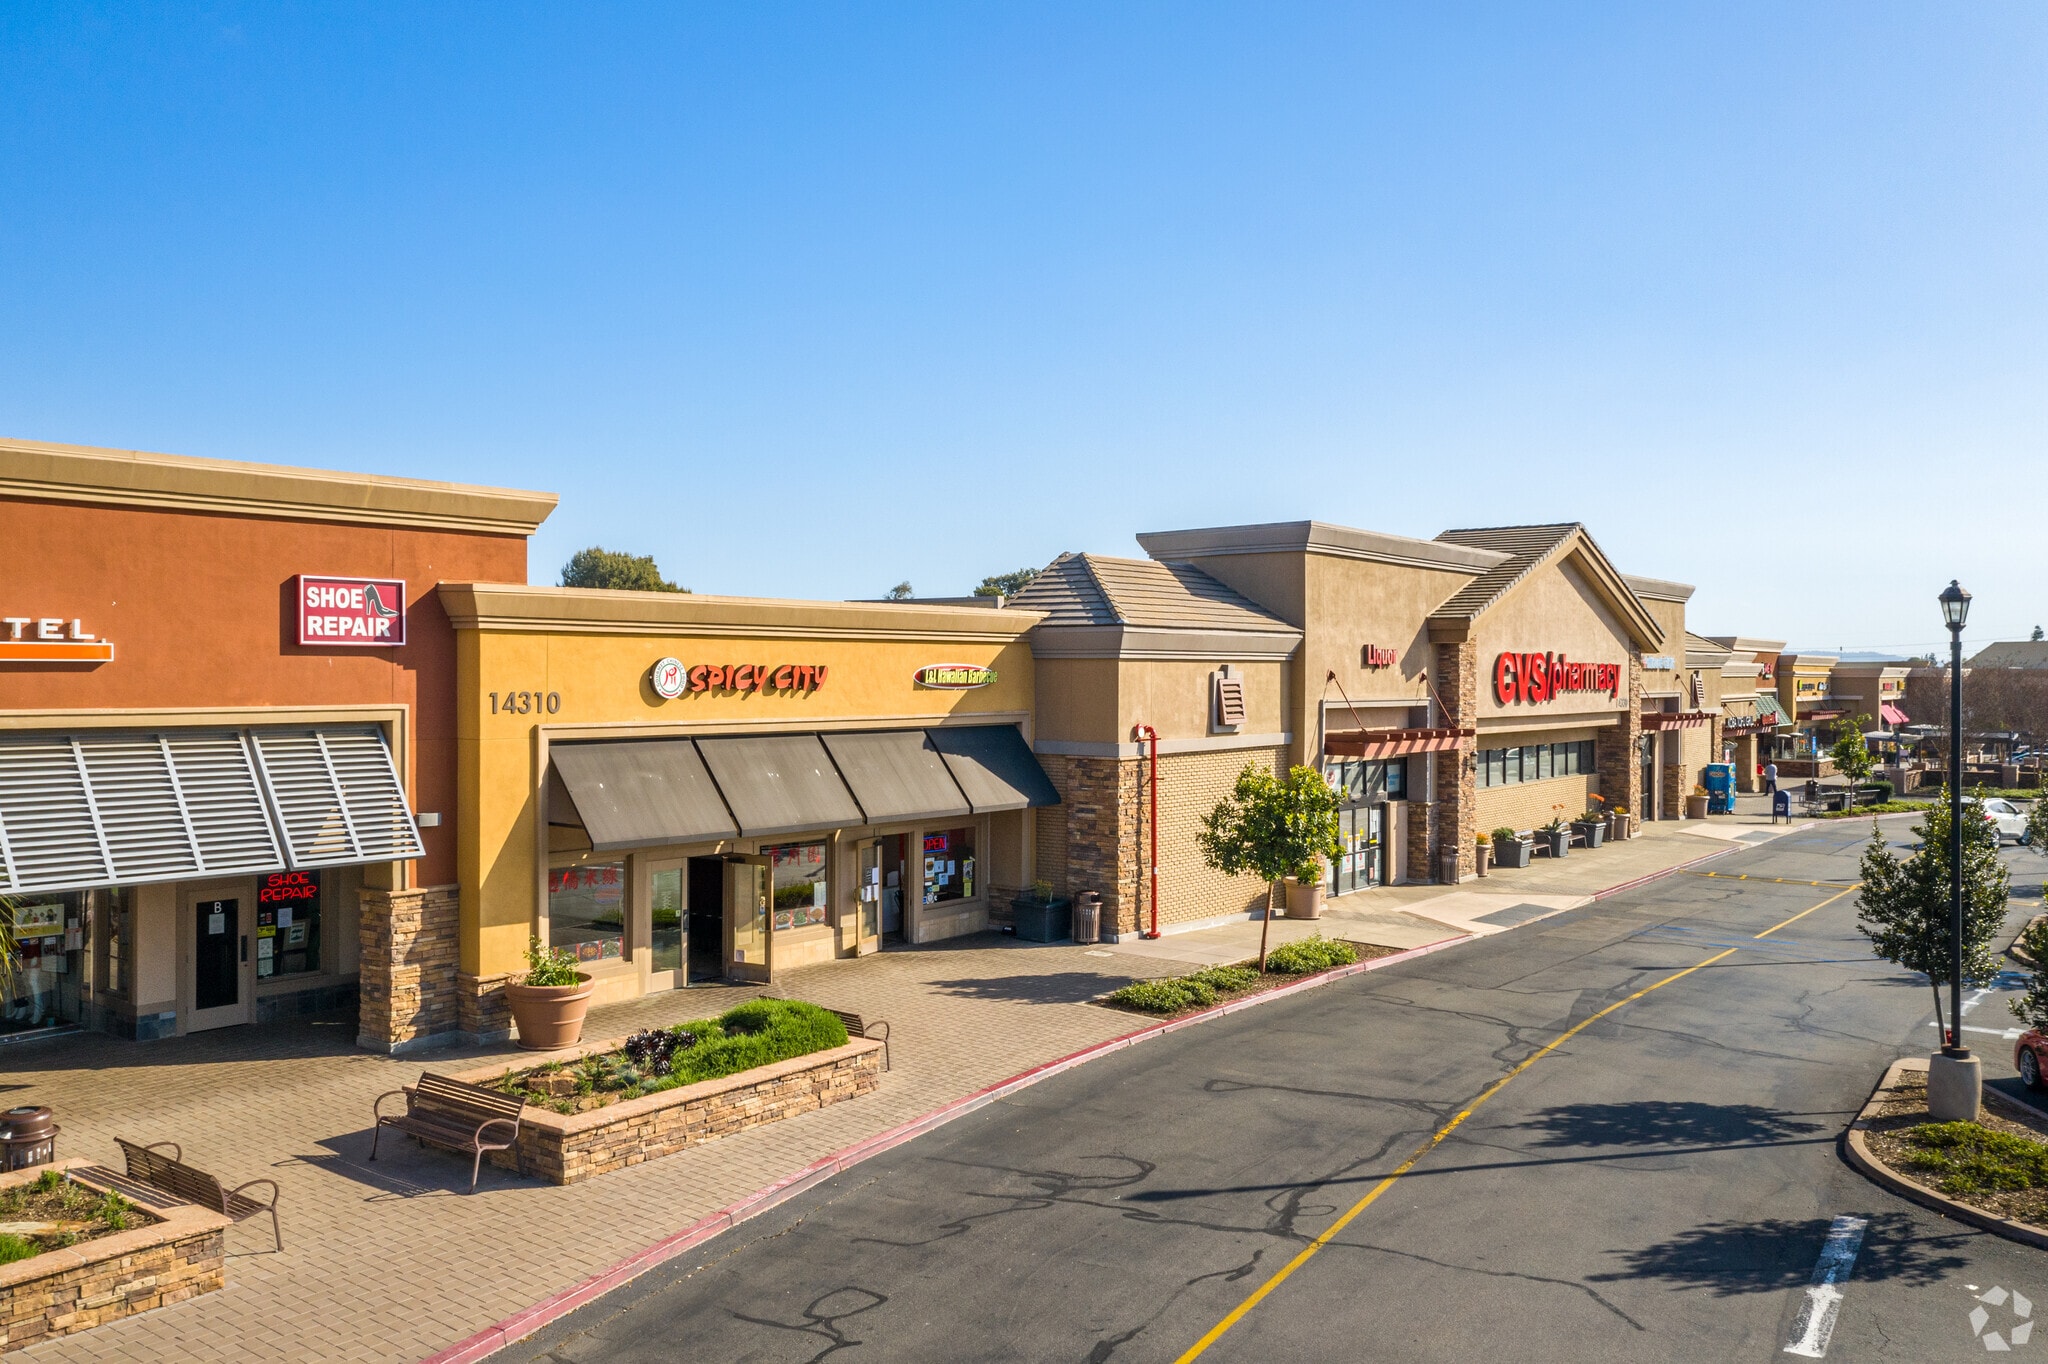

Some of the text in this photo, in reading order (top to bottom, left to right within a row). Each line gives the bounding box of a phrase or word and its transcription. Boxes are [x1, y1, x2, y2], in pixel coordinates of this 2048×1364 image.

[306, 586, 363, 609] SHOE
[307, 615, 391, 637] REPAIR
[1368, 643, 1398, 669] Liquor
[690, 664, 828, 692] SPICY CITY
[925, 668, 998, 683] L&L Hawaiian Barbecue
[1497, 651, 1621, 704] CVS/pharmacy
[488, 691, 561, 714] 14310
[922, 837, 946, 850] OPEN
[268, 871, 310, 887] SHOE
[260, 886, 317, 902] REPAIR
[214, 902, 222, 913] B
